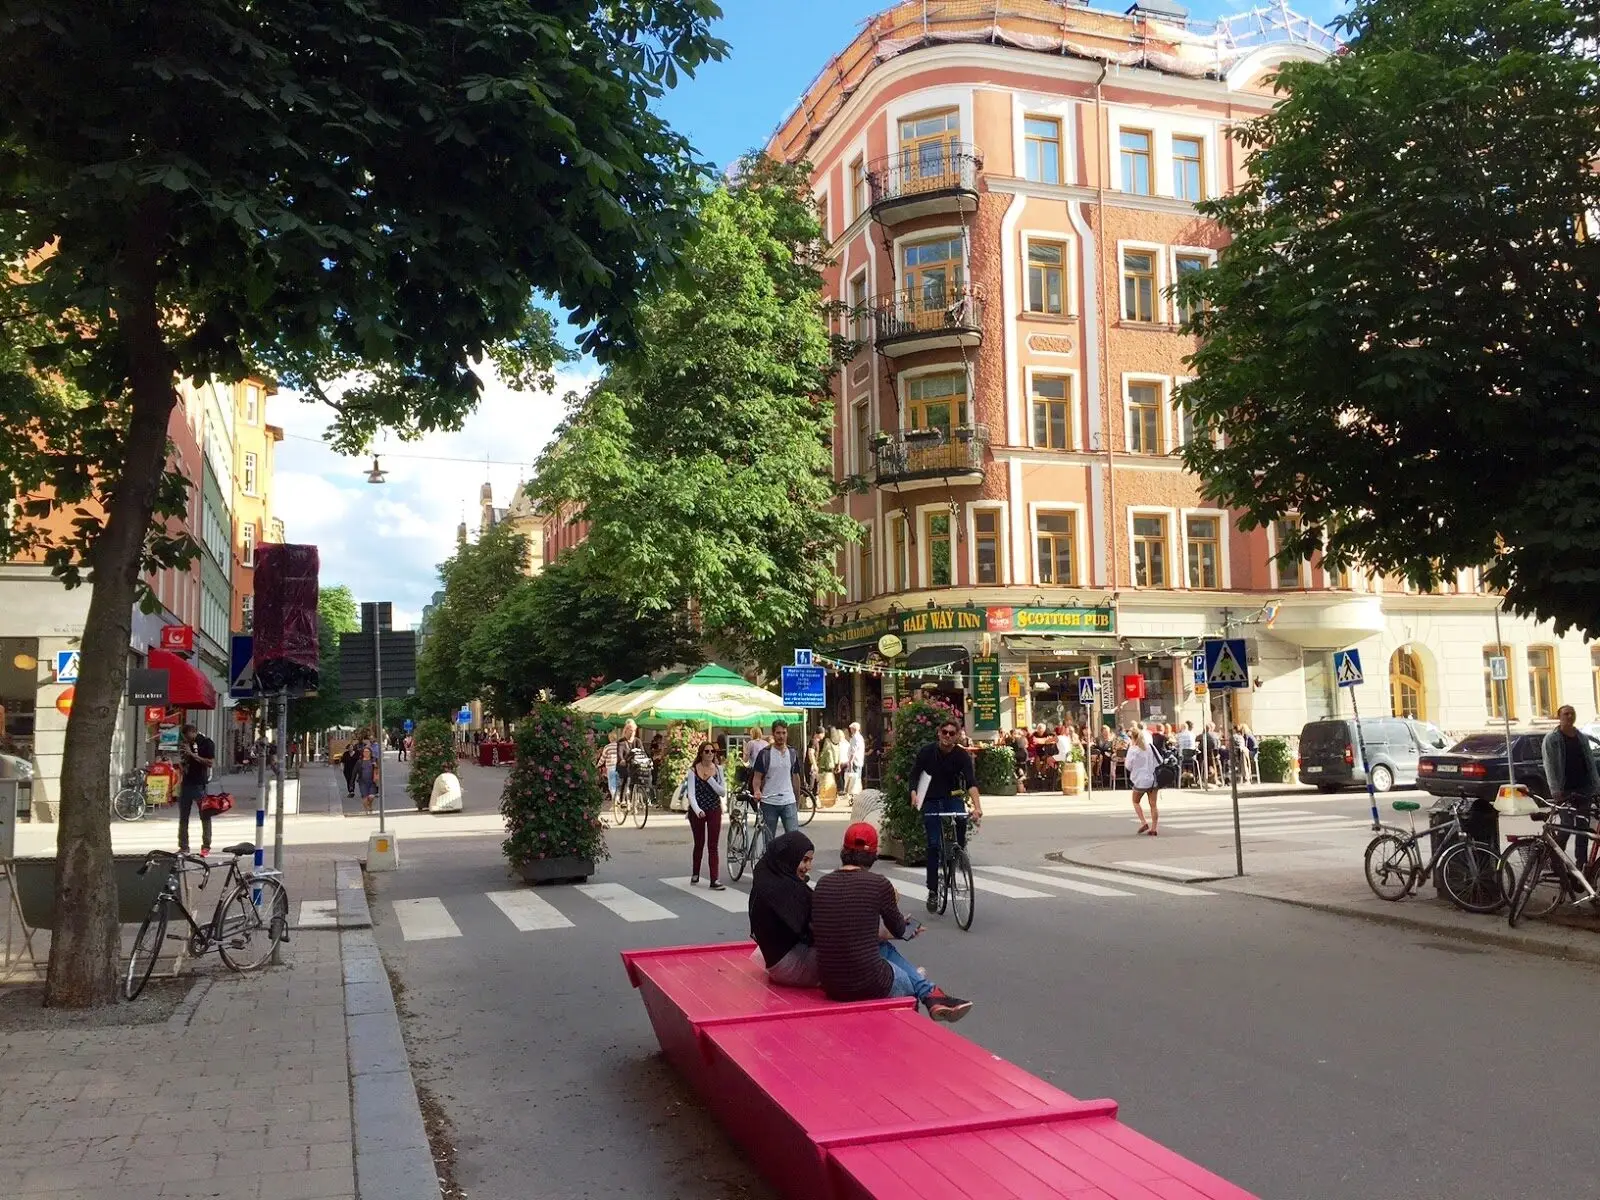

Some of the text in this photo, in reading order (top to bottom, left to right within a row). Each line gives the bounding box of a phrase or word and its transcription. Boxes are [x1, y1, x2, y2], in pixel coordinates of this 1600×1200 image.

[903, 613, 928, 632] HALF
[930, 610, 954, 630] WAY
[958, 611, 980, 629] INN
[1018, 610, 1081, 627] SCOTTISH
[1084, 614, 1109, 627] PUB
[1196, 656, 1203, 670] P
